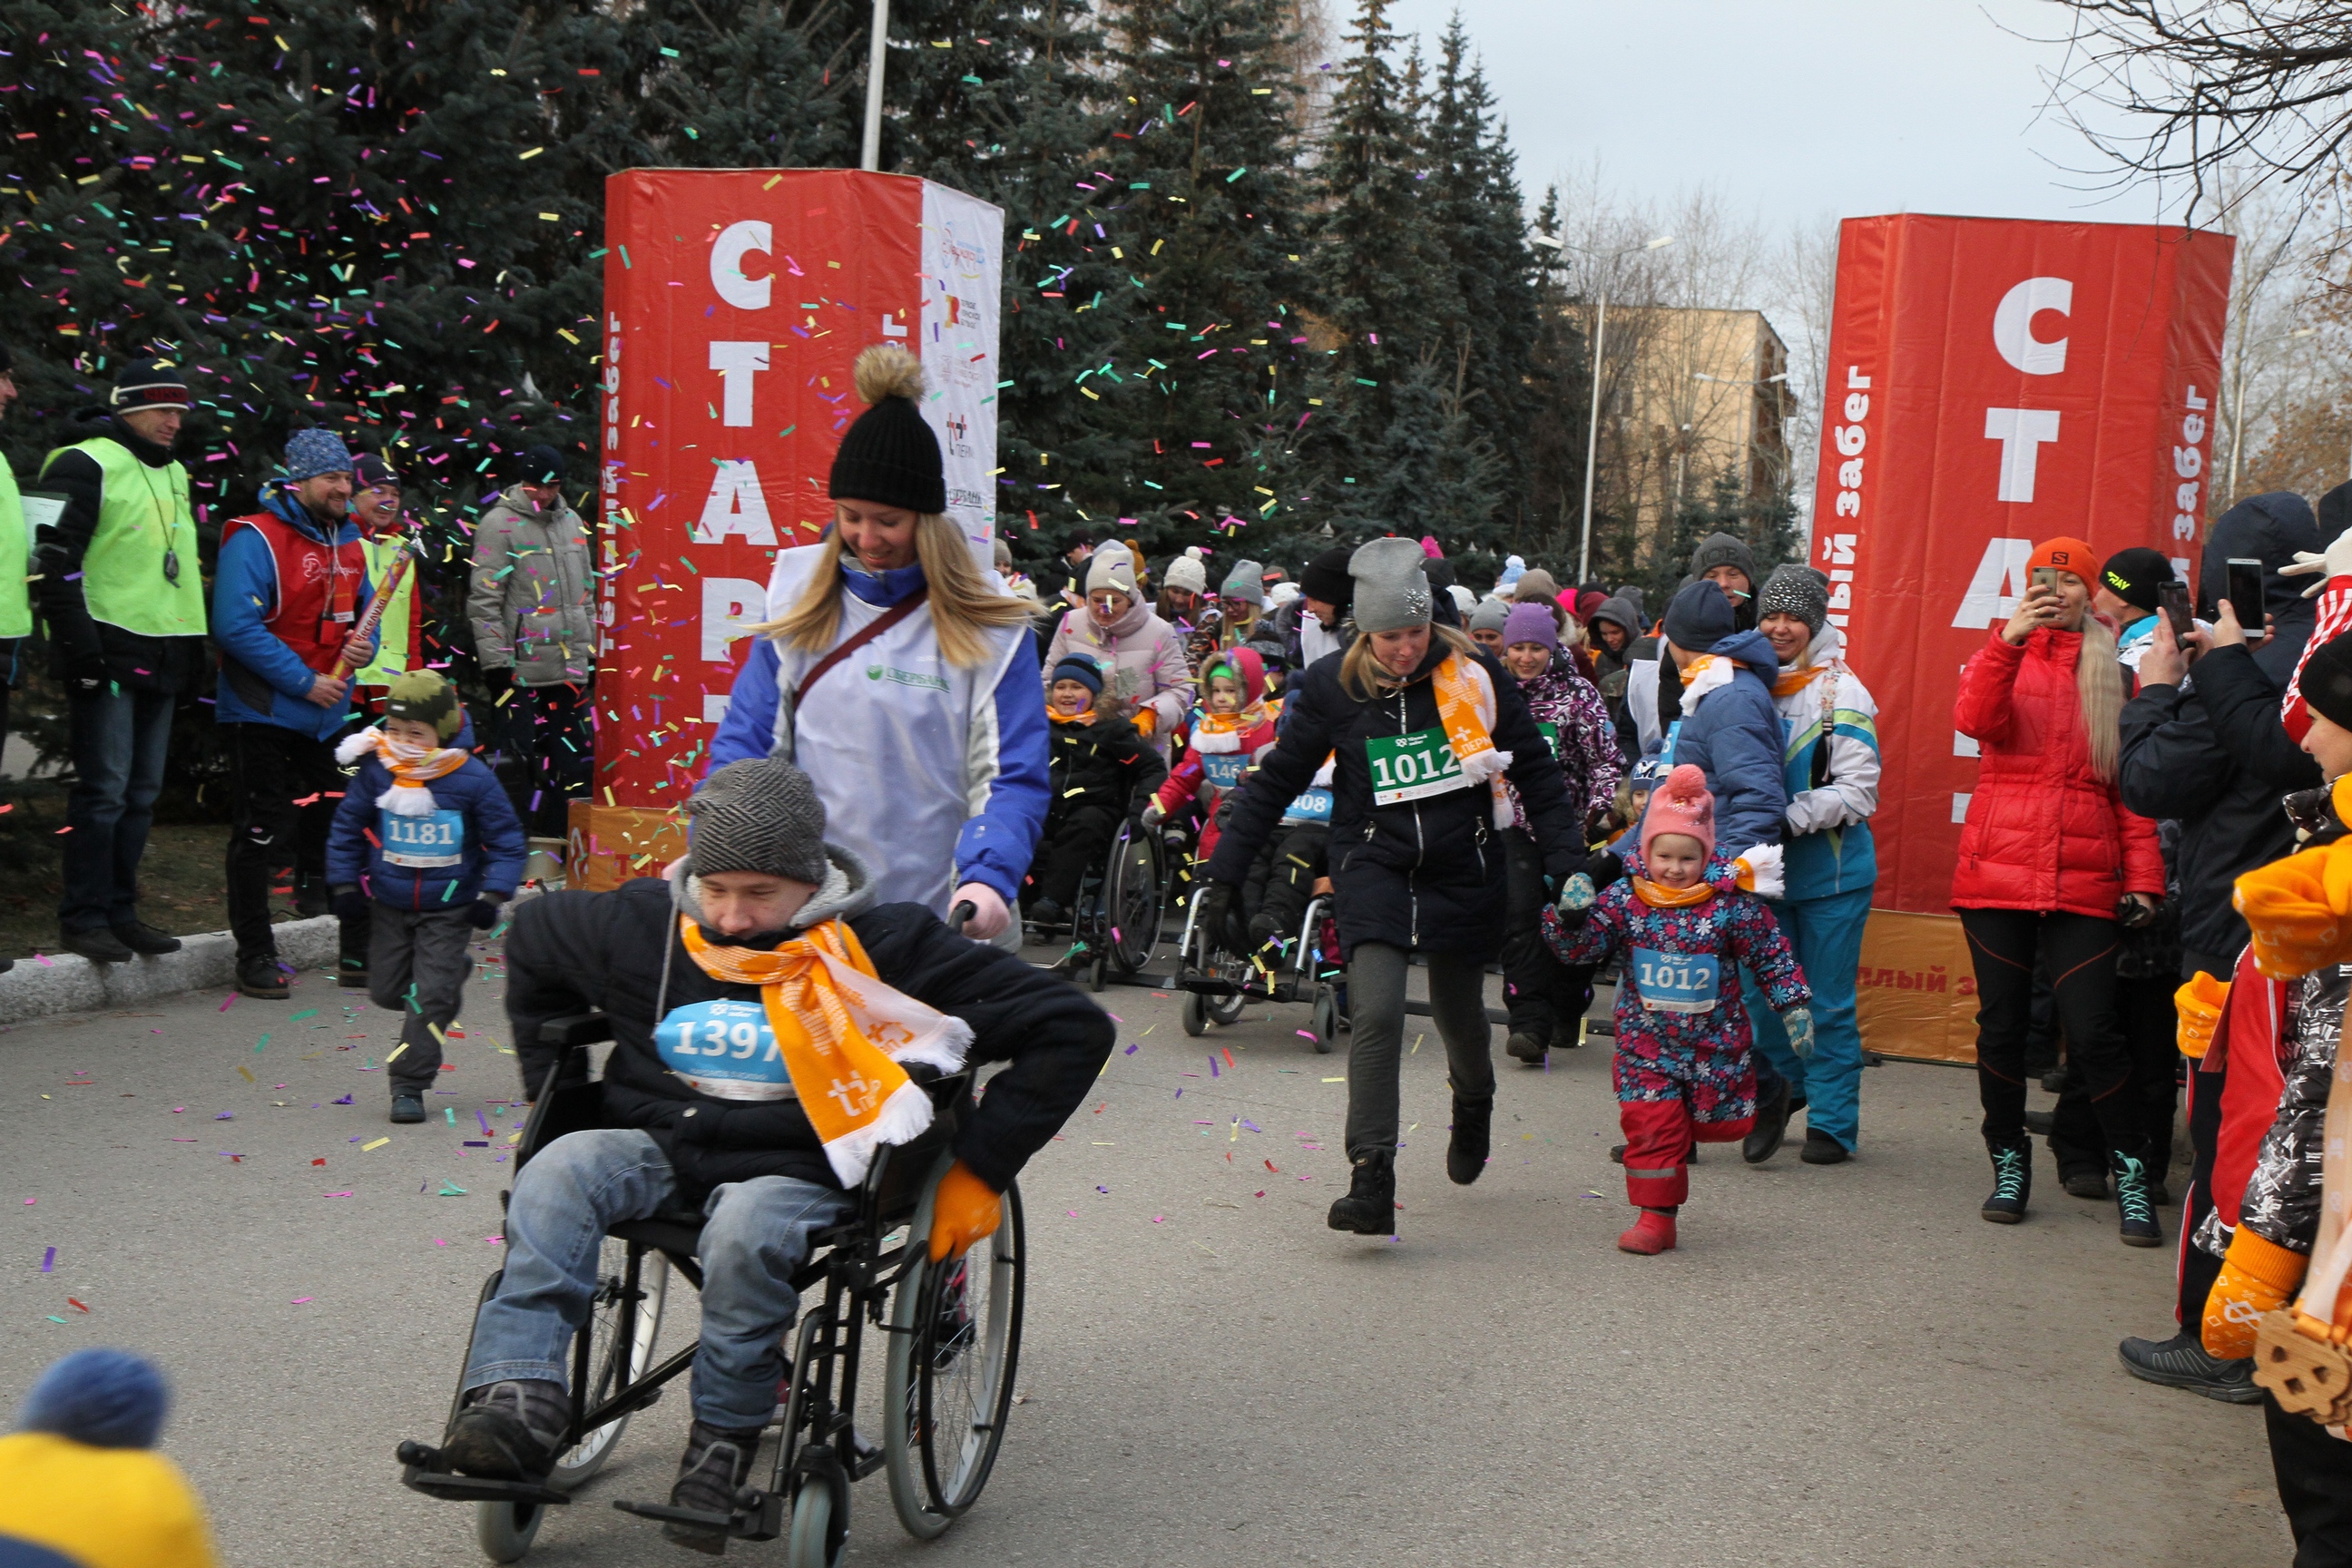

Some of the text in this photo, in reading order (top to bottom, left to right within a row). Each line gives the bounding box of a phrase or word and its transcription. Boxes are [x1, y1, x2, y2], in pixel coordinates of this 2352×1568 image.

[605, 311, 622, 450] забег
[2173, 385, 2208, 542] забег
[1822, 366, 1872, 661] лый забег
[1462, 737, 1494, 753] ПЕРМ
[1208, 763, 1242, 779] 146
[1373, 744, 1460, 787] 1012
[1292, 794, 1328, 813] 408
[388, 820, 455, 845] 1181
[1640, 963, 1710, 991] 1012
[1856, 965, 1947, 993] плый
[673, 1019, 780, 1062] 1397
